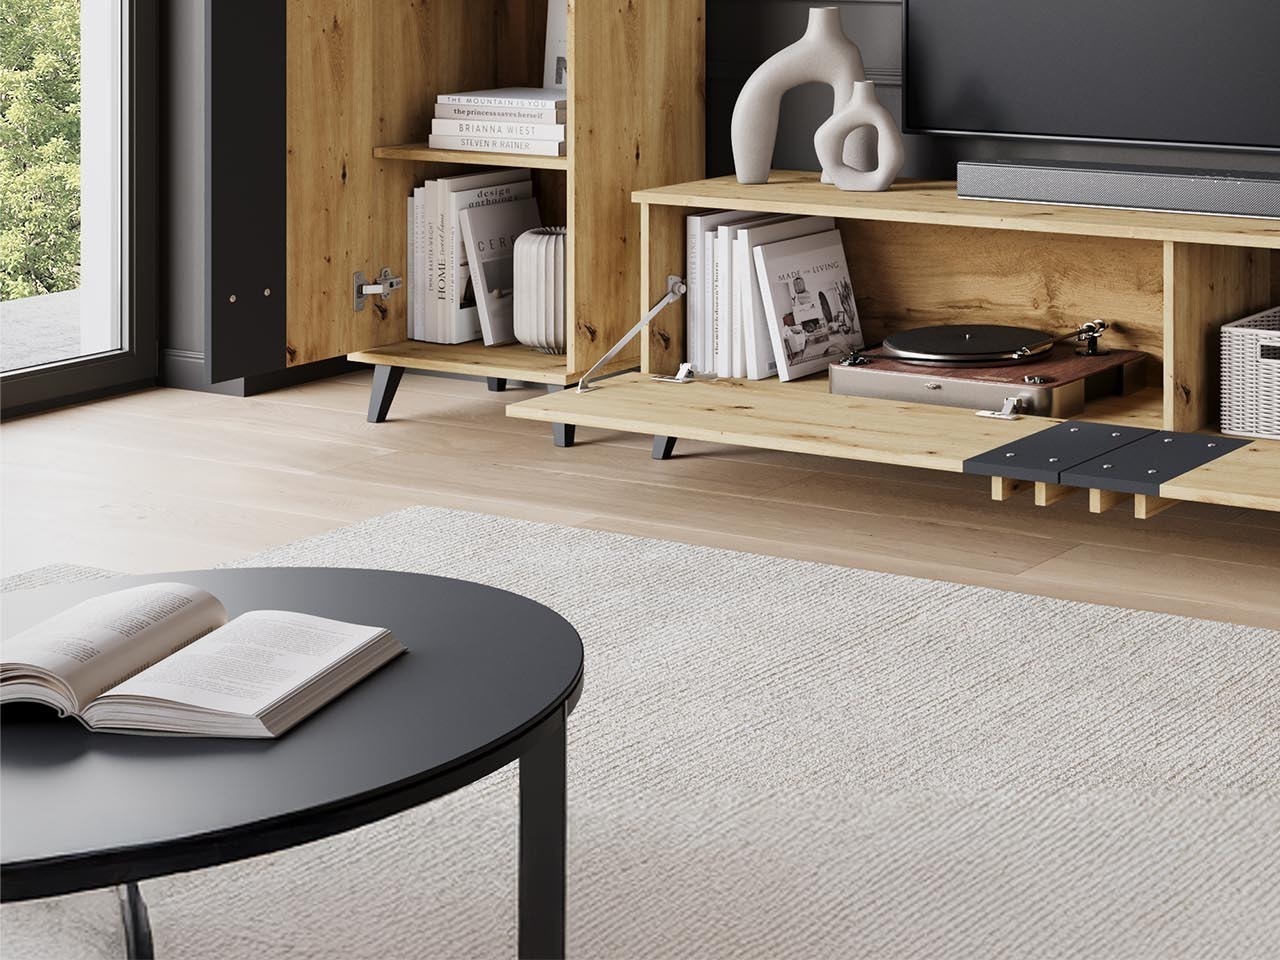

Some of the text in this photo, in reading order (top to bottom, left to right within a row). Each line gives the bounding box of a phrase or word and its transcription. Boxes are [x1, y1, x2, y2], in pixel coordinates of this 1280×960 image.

[518, 111, 543, 119] herself
[459, 124, 536, 135] BRIANNA WIEST
[460, 138, 489, 147] STEVEN
[477, 187, 511, 198] design
[778, 270, 801, 281] MADE
[812, 261, 840, 274] LIVING
[438, 257, 446, 300] HOME
